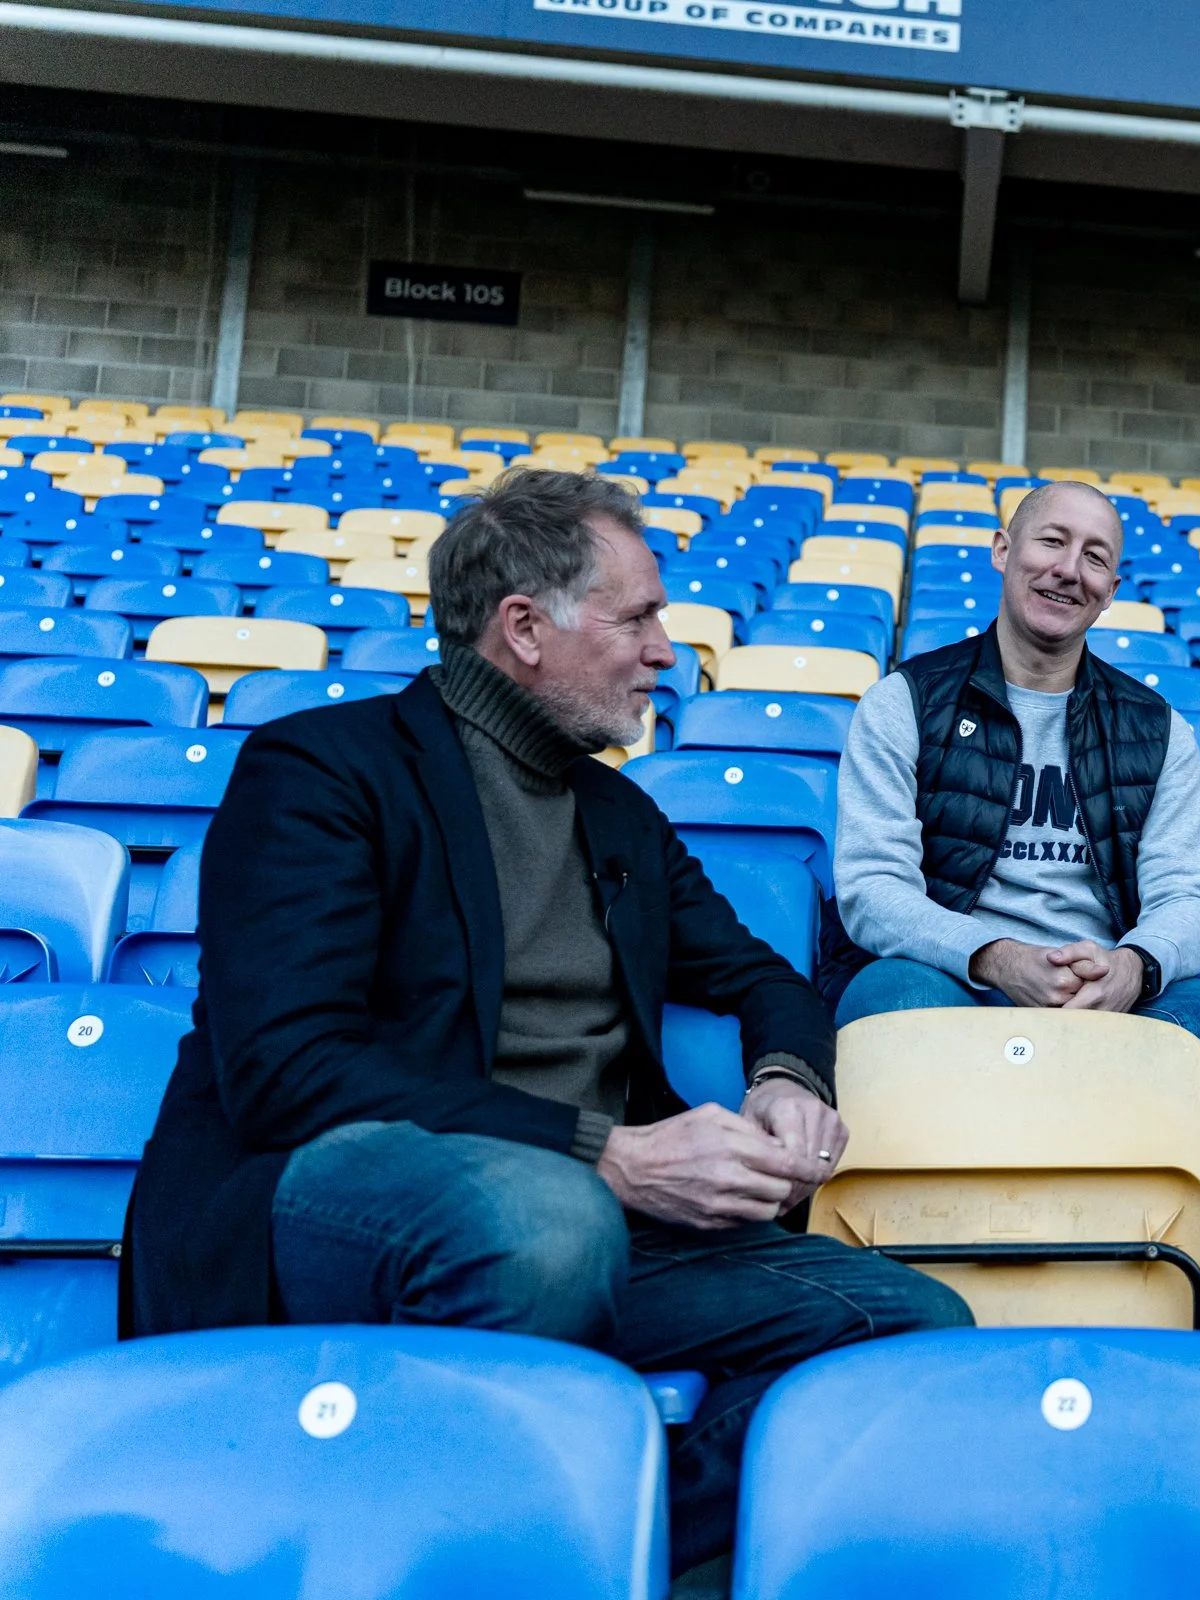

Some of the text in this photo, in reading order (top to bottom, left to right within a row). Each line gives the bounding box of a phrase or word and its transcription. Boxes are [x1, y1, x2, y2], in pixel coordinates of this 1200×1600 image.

[686, 4, 729, 20] OF
[746, 10, 949, 44] COMPANIES
[384, 276, 505, 306] Block 105
[78, 1026, 93, 1036] 20
[1013, 1046, 1026, 1056] 22
